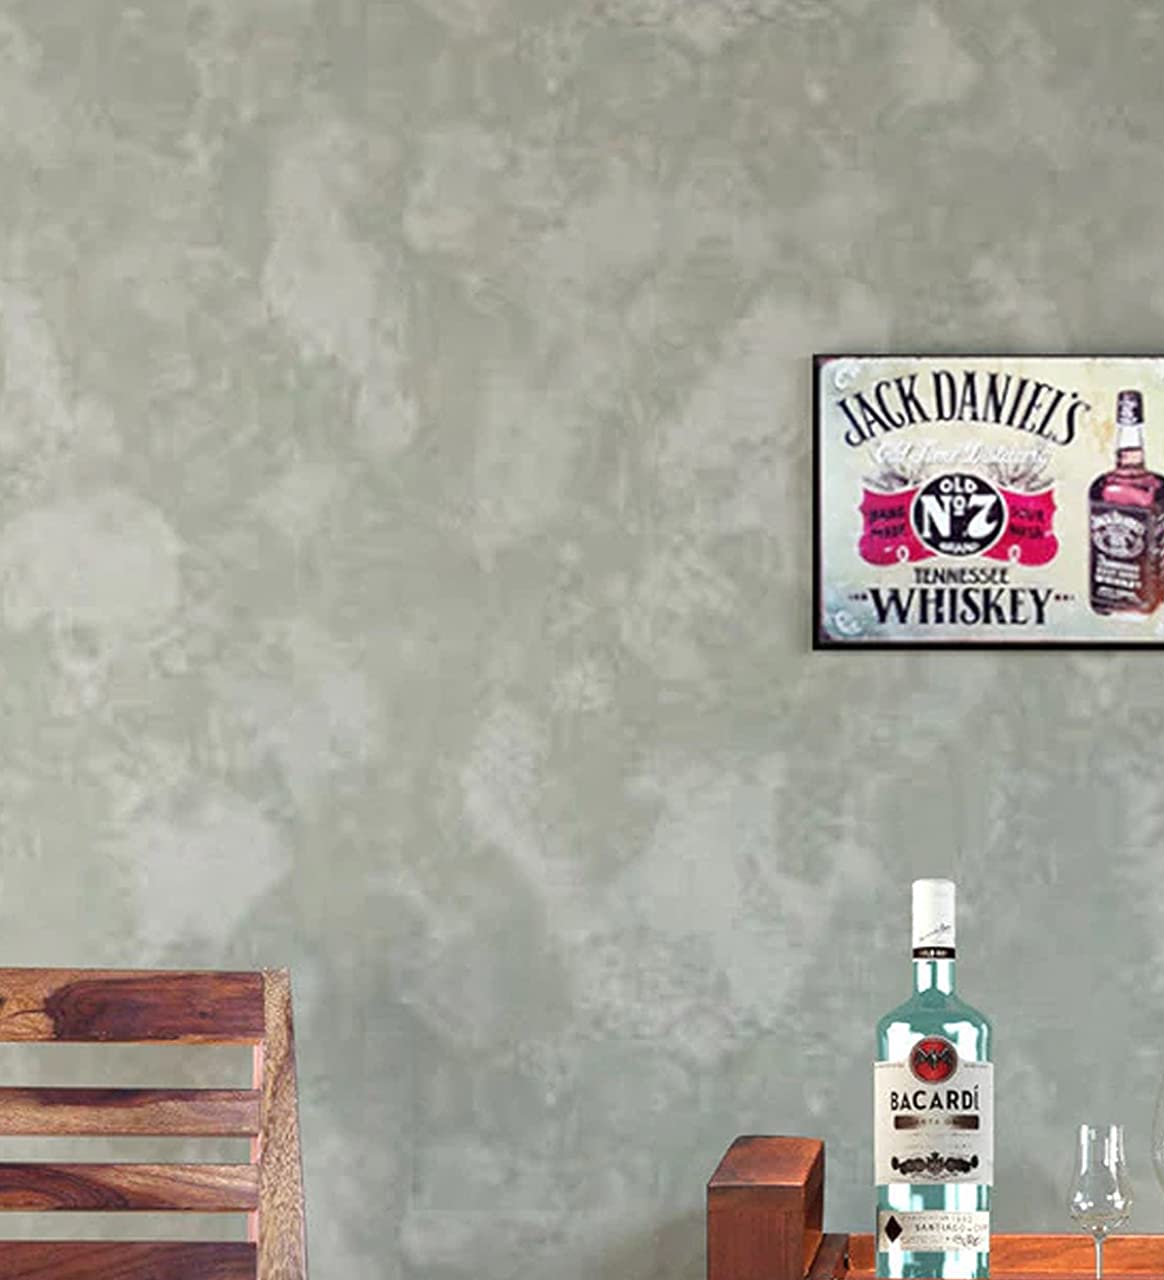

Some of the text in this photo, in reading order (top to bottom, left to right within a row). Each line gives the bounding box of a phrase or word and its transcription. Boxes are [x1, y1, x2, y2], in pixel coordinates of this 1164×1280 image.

[837, 369, 1092, 447] JACK DANIEL'S
[939, 477, 978, 493] OLD
[914, 566, 1010, 584] TENNESSEE
[868, 587, 1056, 626] WHISKEY
[890, 1084, 979, 1111] BACARDÍ
